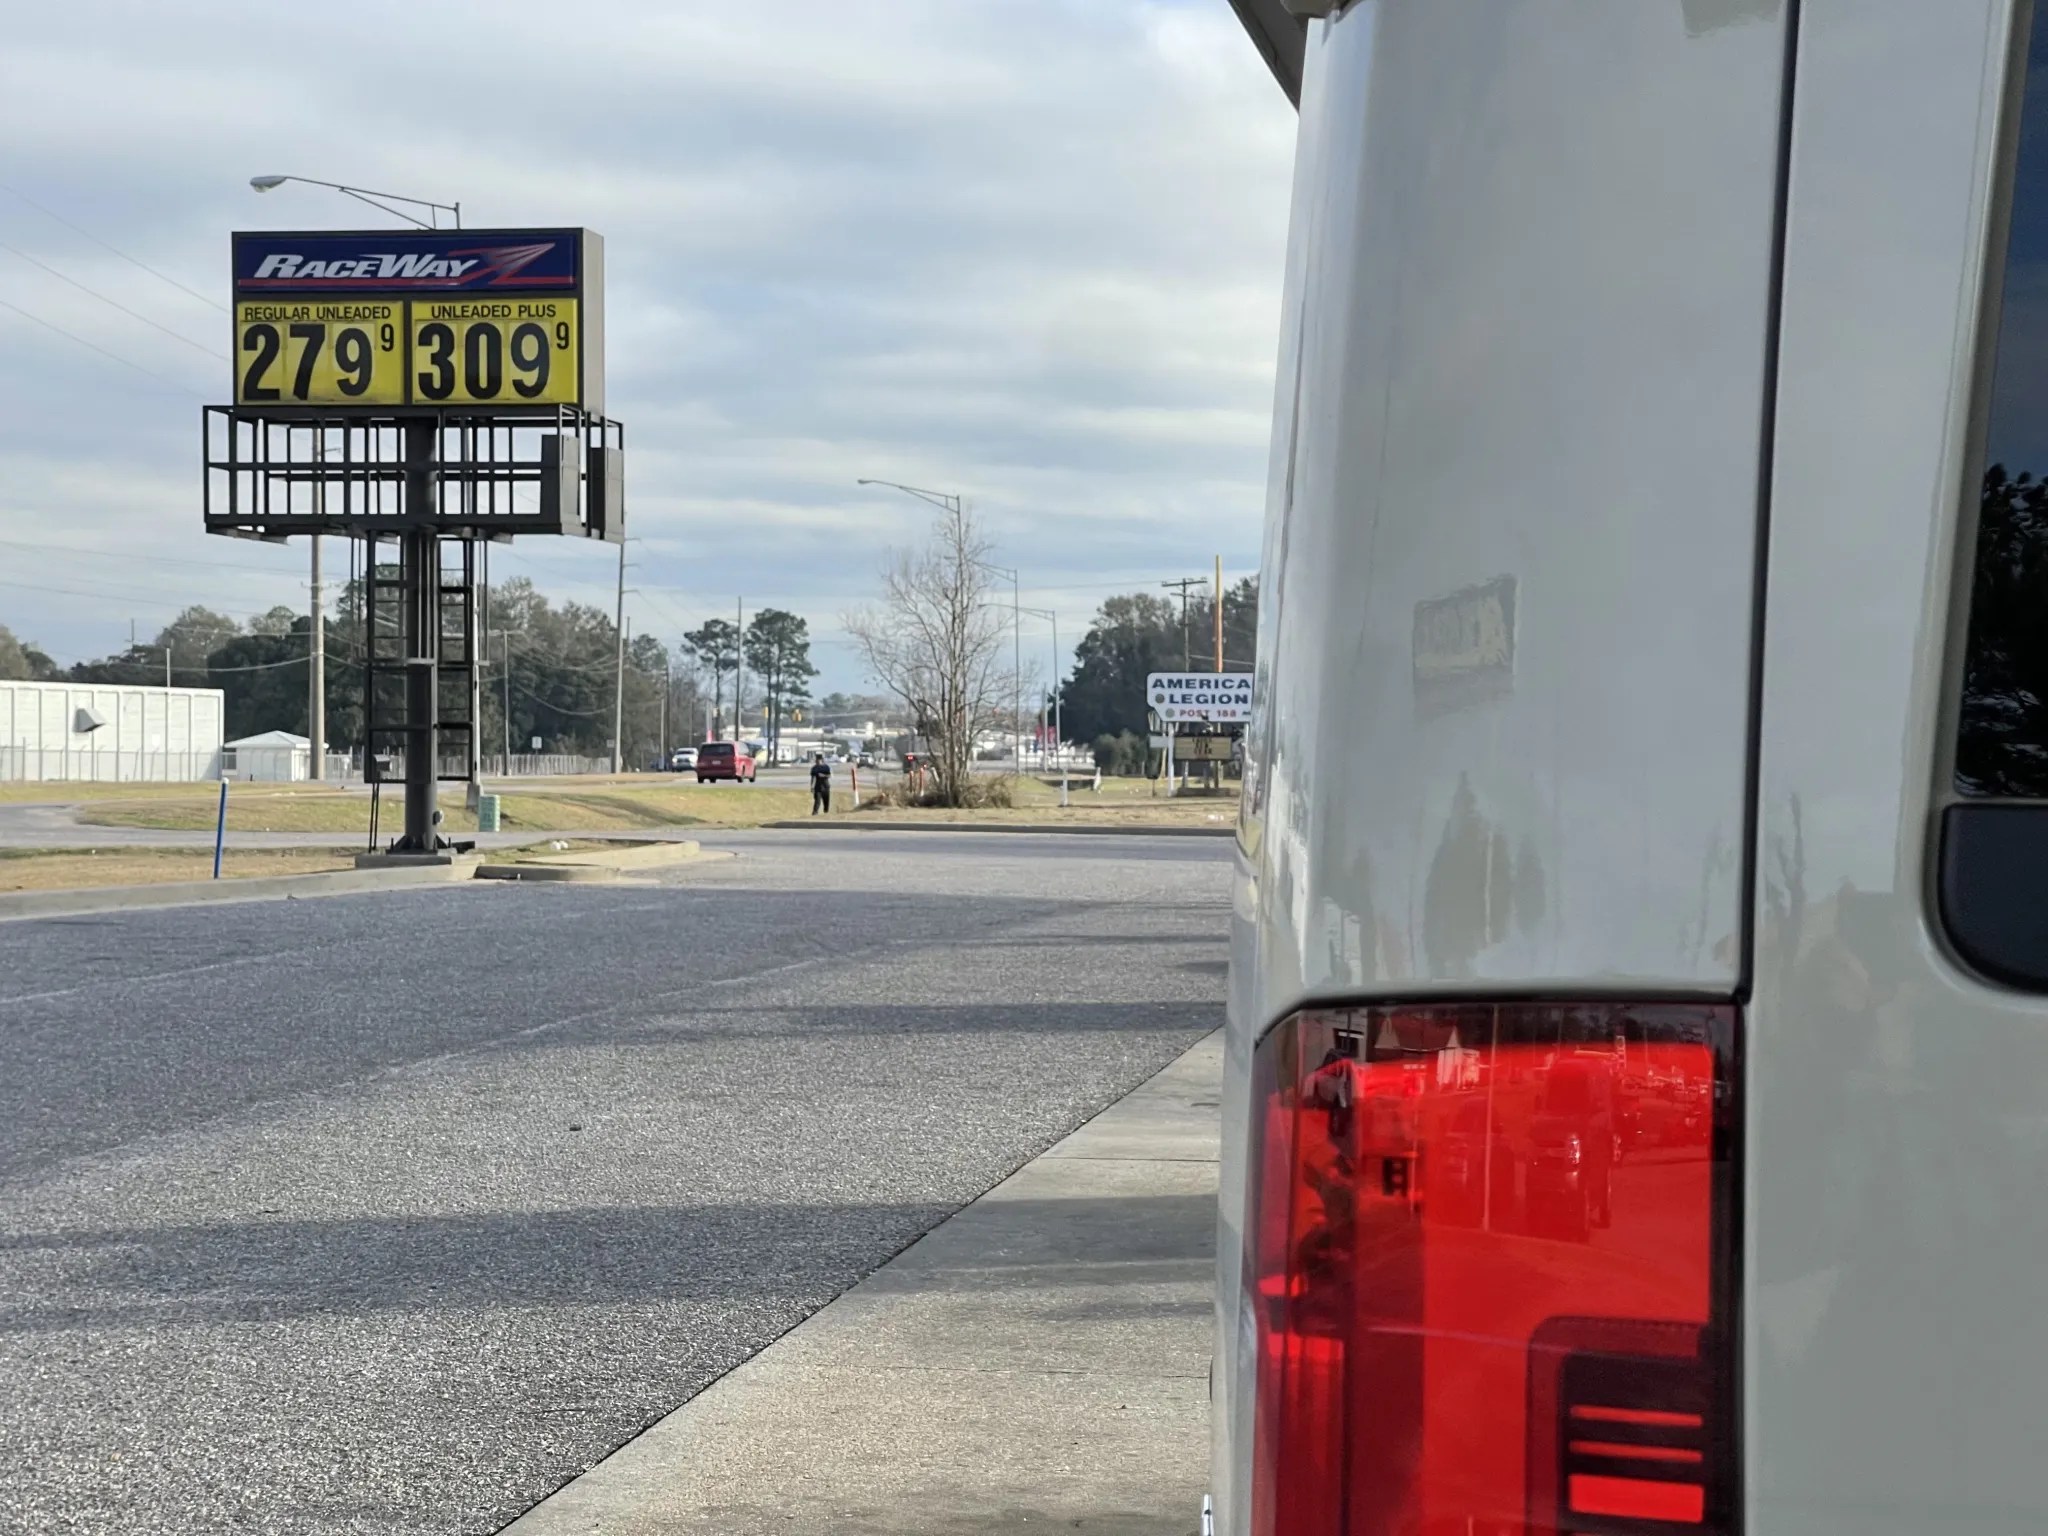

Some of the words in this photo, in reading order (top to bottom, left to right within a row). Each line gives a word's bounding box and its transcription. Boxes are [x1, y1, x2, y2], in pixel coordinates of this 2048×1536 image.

[244, 306, 310, 320] REGULAR
[316, 306, 392, 320] UNLEADED
[431, 305, 512, 319] UNLEADED
[518, 304, 556, 318] PLUS
[1169, 693, 1248, 704] LEGION
[1179, 709, 1210, 717] POST
